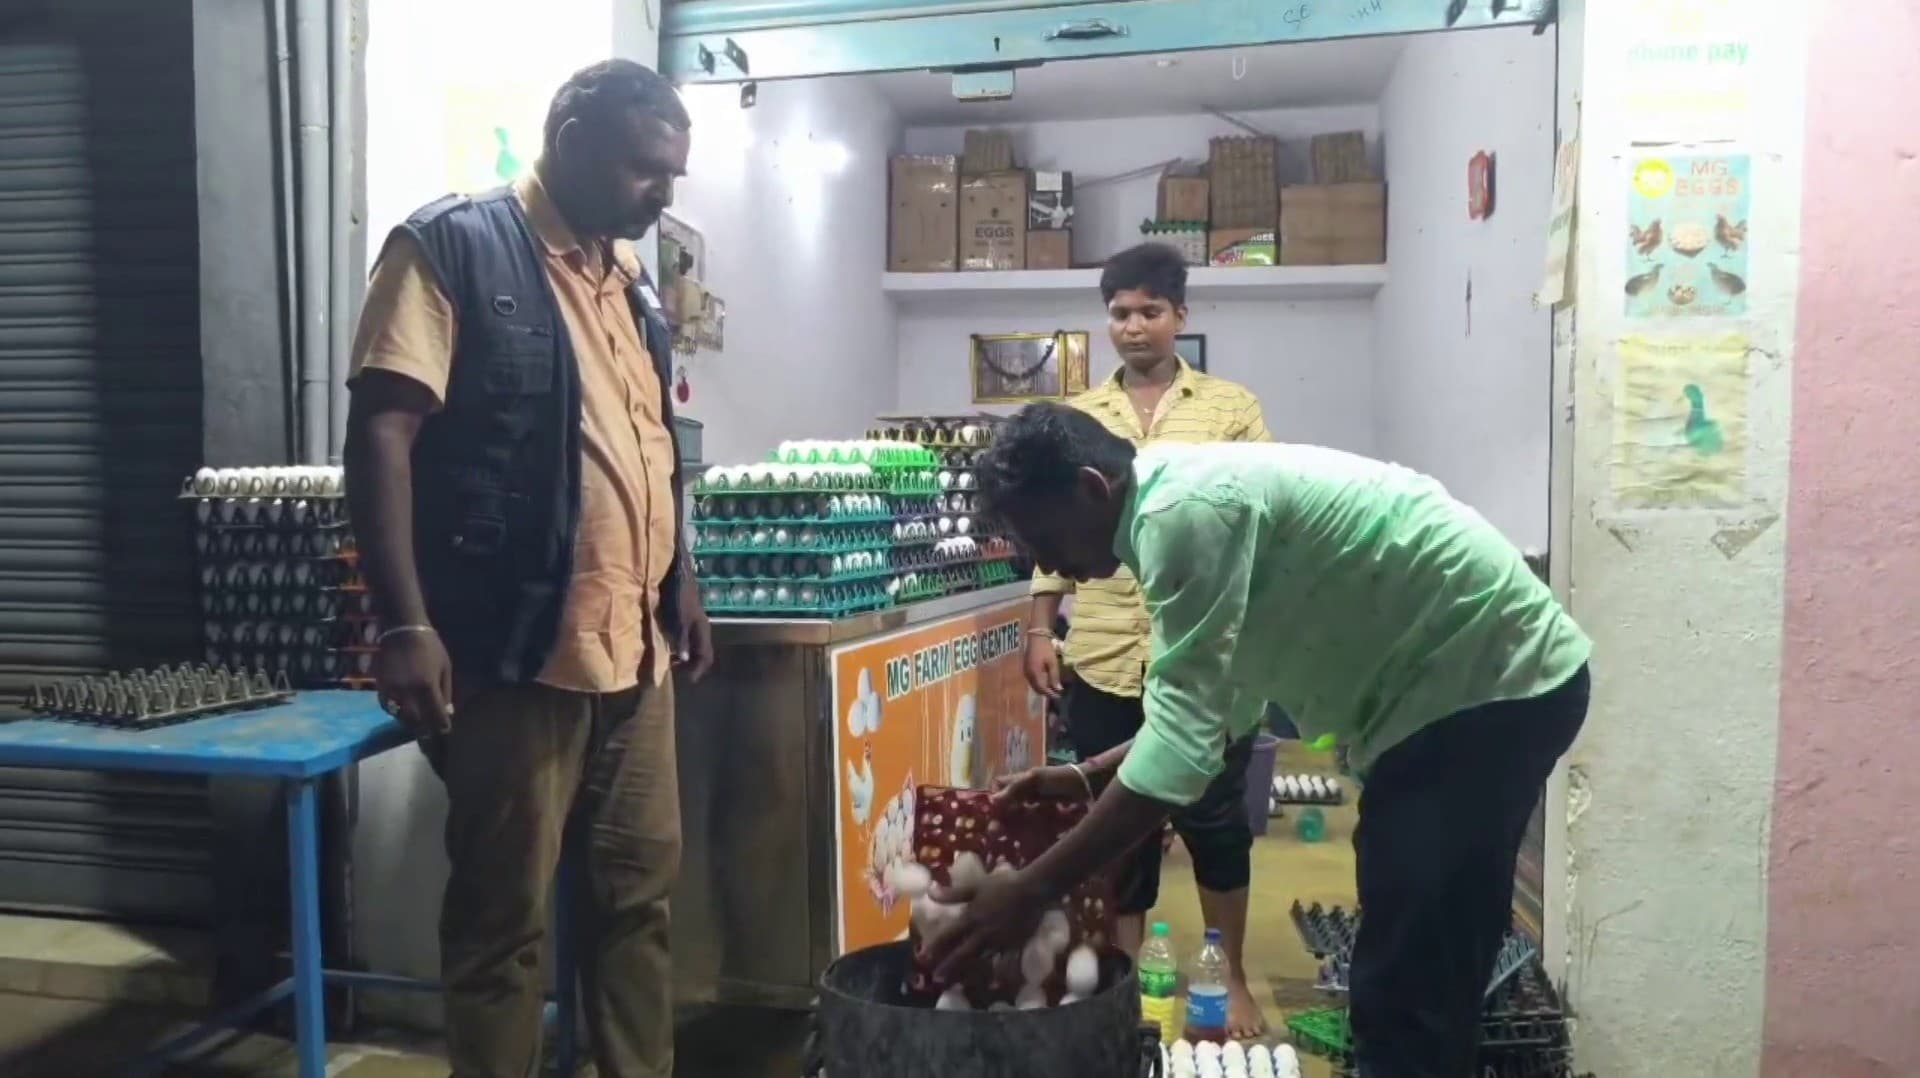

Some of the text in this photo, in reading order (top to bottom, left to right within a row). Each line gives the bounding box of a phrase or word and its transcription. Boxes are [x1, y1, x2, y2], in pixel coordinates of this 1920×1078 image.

[1691, 159, 1728, 176] MG
[975, 226, 1015, 238] EGGS
[886, 620, 1020, 699] MG FARM EGG CENTRE
